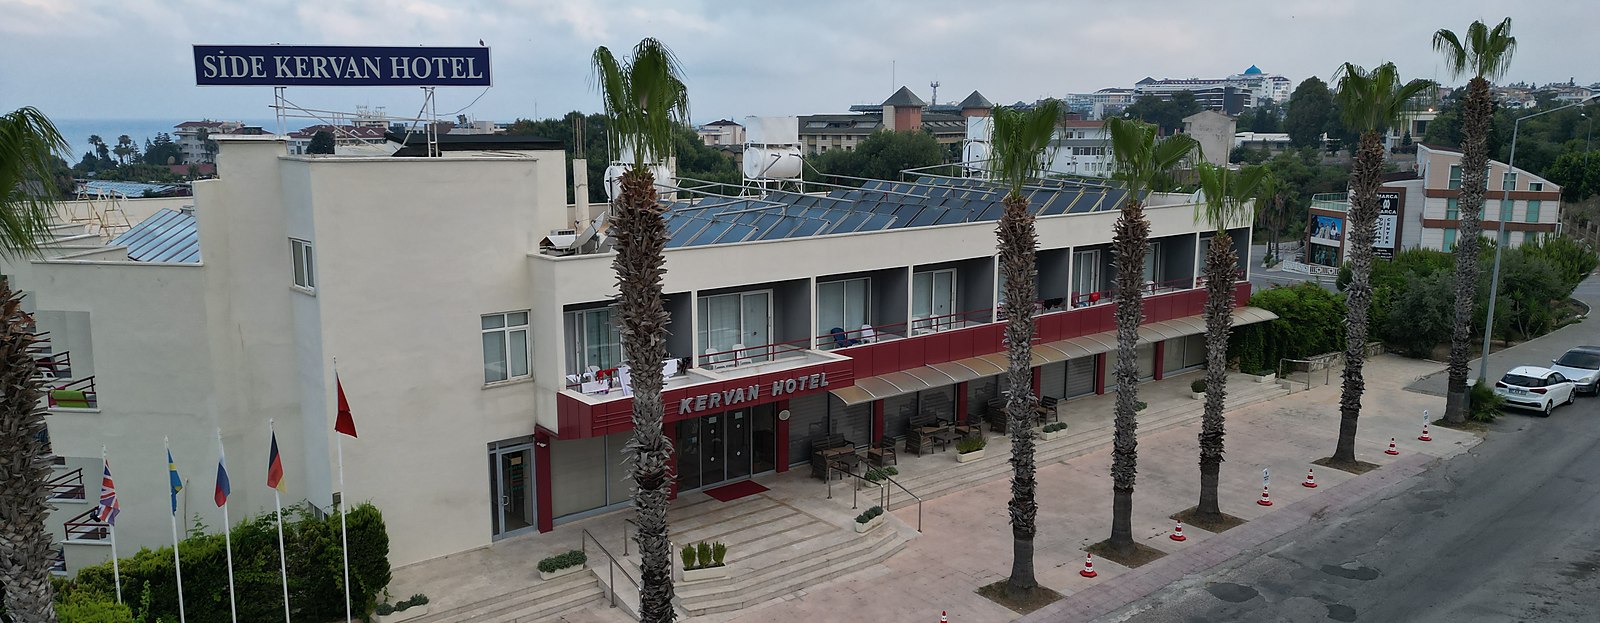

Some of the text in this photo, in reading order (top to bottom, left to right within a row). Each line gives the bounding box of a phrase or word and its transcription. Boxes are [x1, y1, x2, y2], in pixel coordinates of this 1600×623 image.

[203, 50, 483, 79] SİDE KERVAN HOTEL
[679, 372, 829, 414] KERVAN HOTEL
